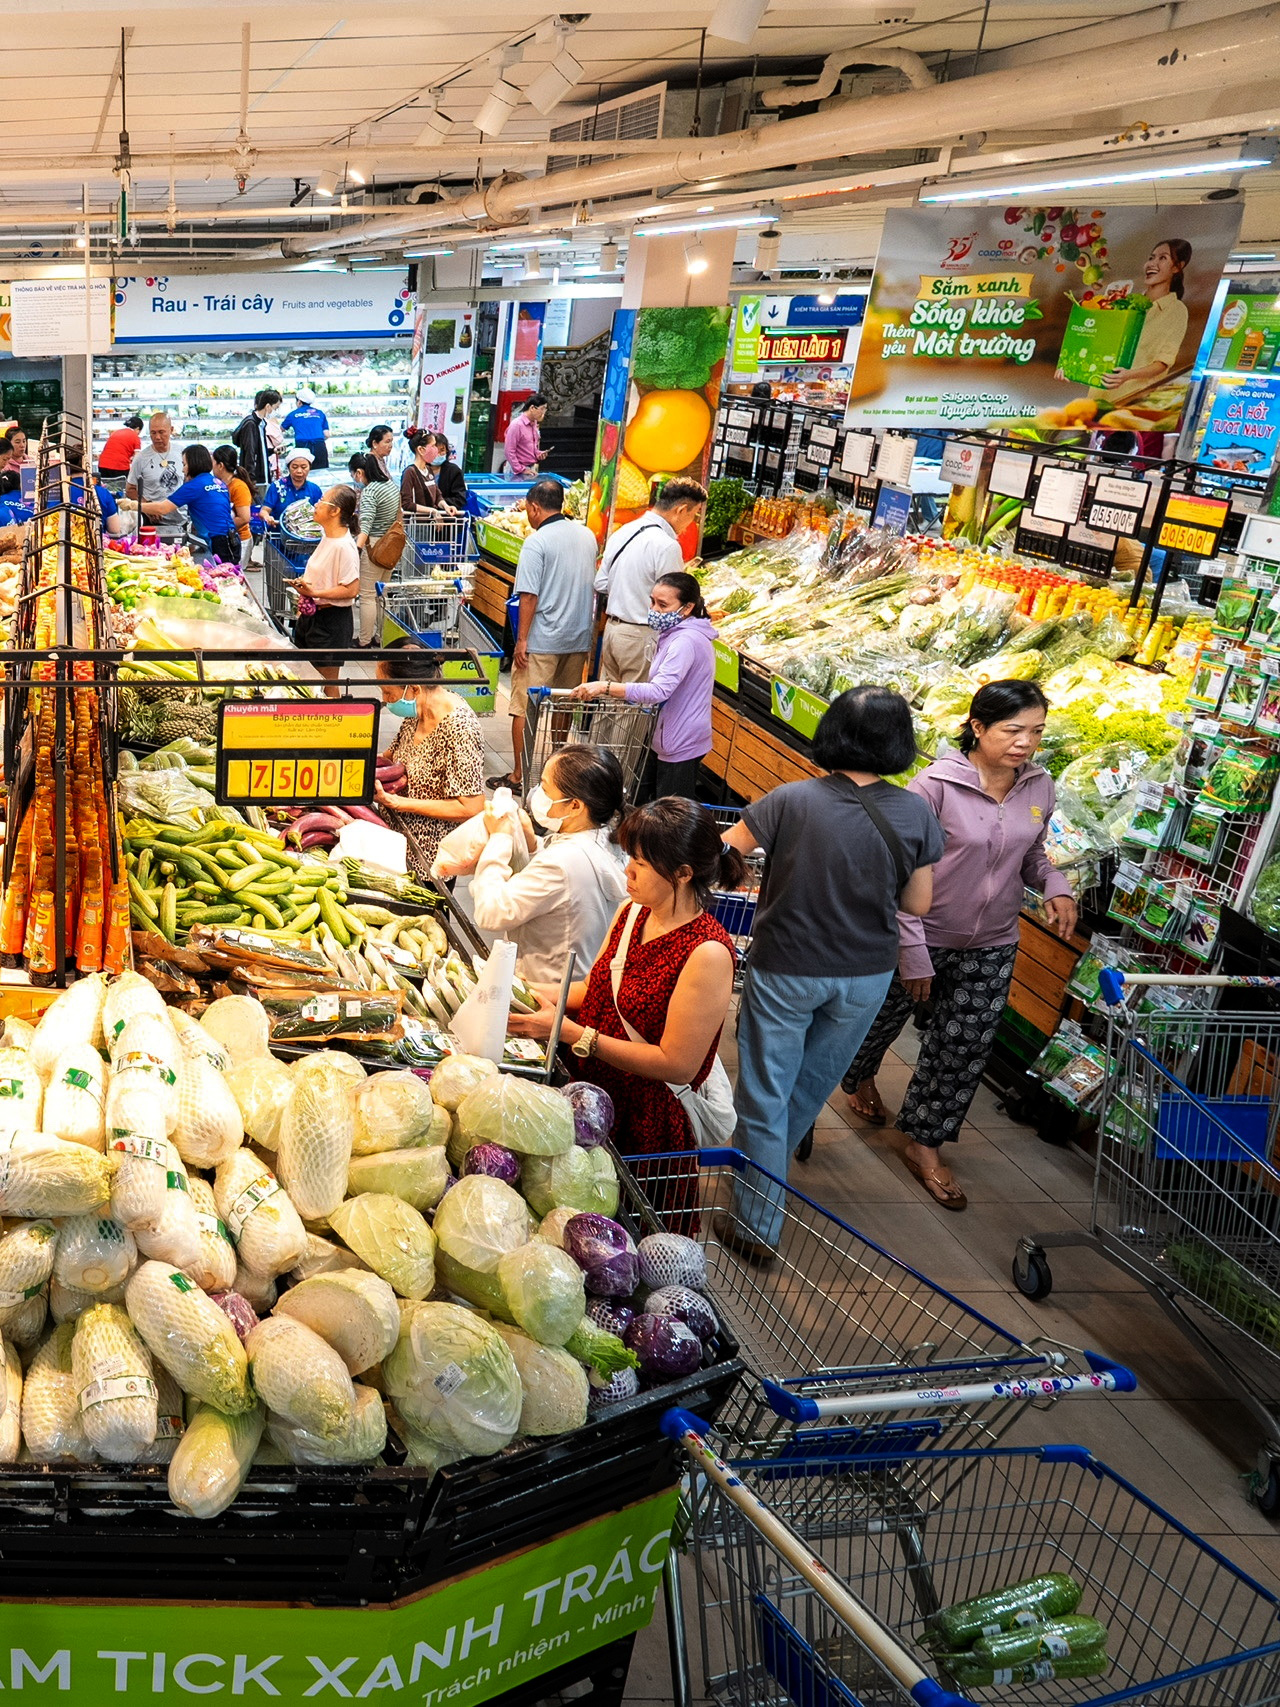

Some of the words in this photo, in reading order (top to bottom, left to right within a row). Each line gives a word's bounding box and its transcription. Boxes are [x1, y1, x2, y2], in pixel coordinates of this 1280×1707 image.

[931, 276, 972, 296] Sắm
[977, 277, 1022, 293] xanh
[152, 296, 187, 313] Rau
[204, 295, 236, 312] Trái
[242, 294, 273, 313] cây
[282, 300, 306, 309] Fruits
[308, 300, 325, 309] and
[327, 299, 373, 310] vegetables
[909, 297, 966, 331] Sống
[970, 298, 1025, 325] khỏe
[882, 323, 916, 338] Thêm
[772, 336, 800, 358] LÊN
[831, 339, 841, 357] 1
[881, 340, 907, 358] yêu
[913, 330, 958, 356] Môi
[959, 332, 1037, 362] trường
[435, 360, 470, 379] KIKKOMAN
[941, 392, 977, 404] Saigon
[979, 392, 1009, 404] Co.op
[983, 405, 1018, 417] Thanh
[1020, 404, 1037, 417] Hà
[1161, 527, 1204, 549] 30.500
[260, 704, 277, 712] mãi
[332, 714, 343, 723] kg
[253, 762, 338, 790] 7.500
[97, 1650, 284, 1696] TICK
[302, 1604, 505, 1698] XANH
[523, 1528, 671, 1627] TRÁC
[422, 1666, 491, 1707] Trách
[497, 1630, 571, 1675] nhiệm
[591, 1594, 646, 1630] Minh
